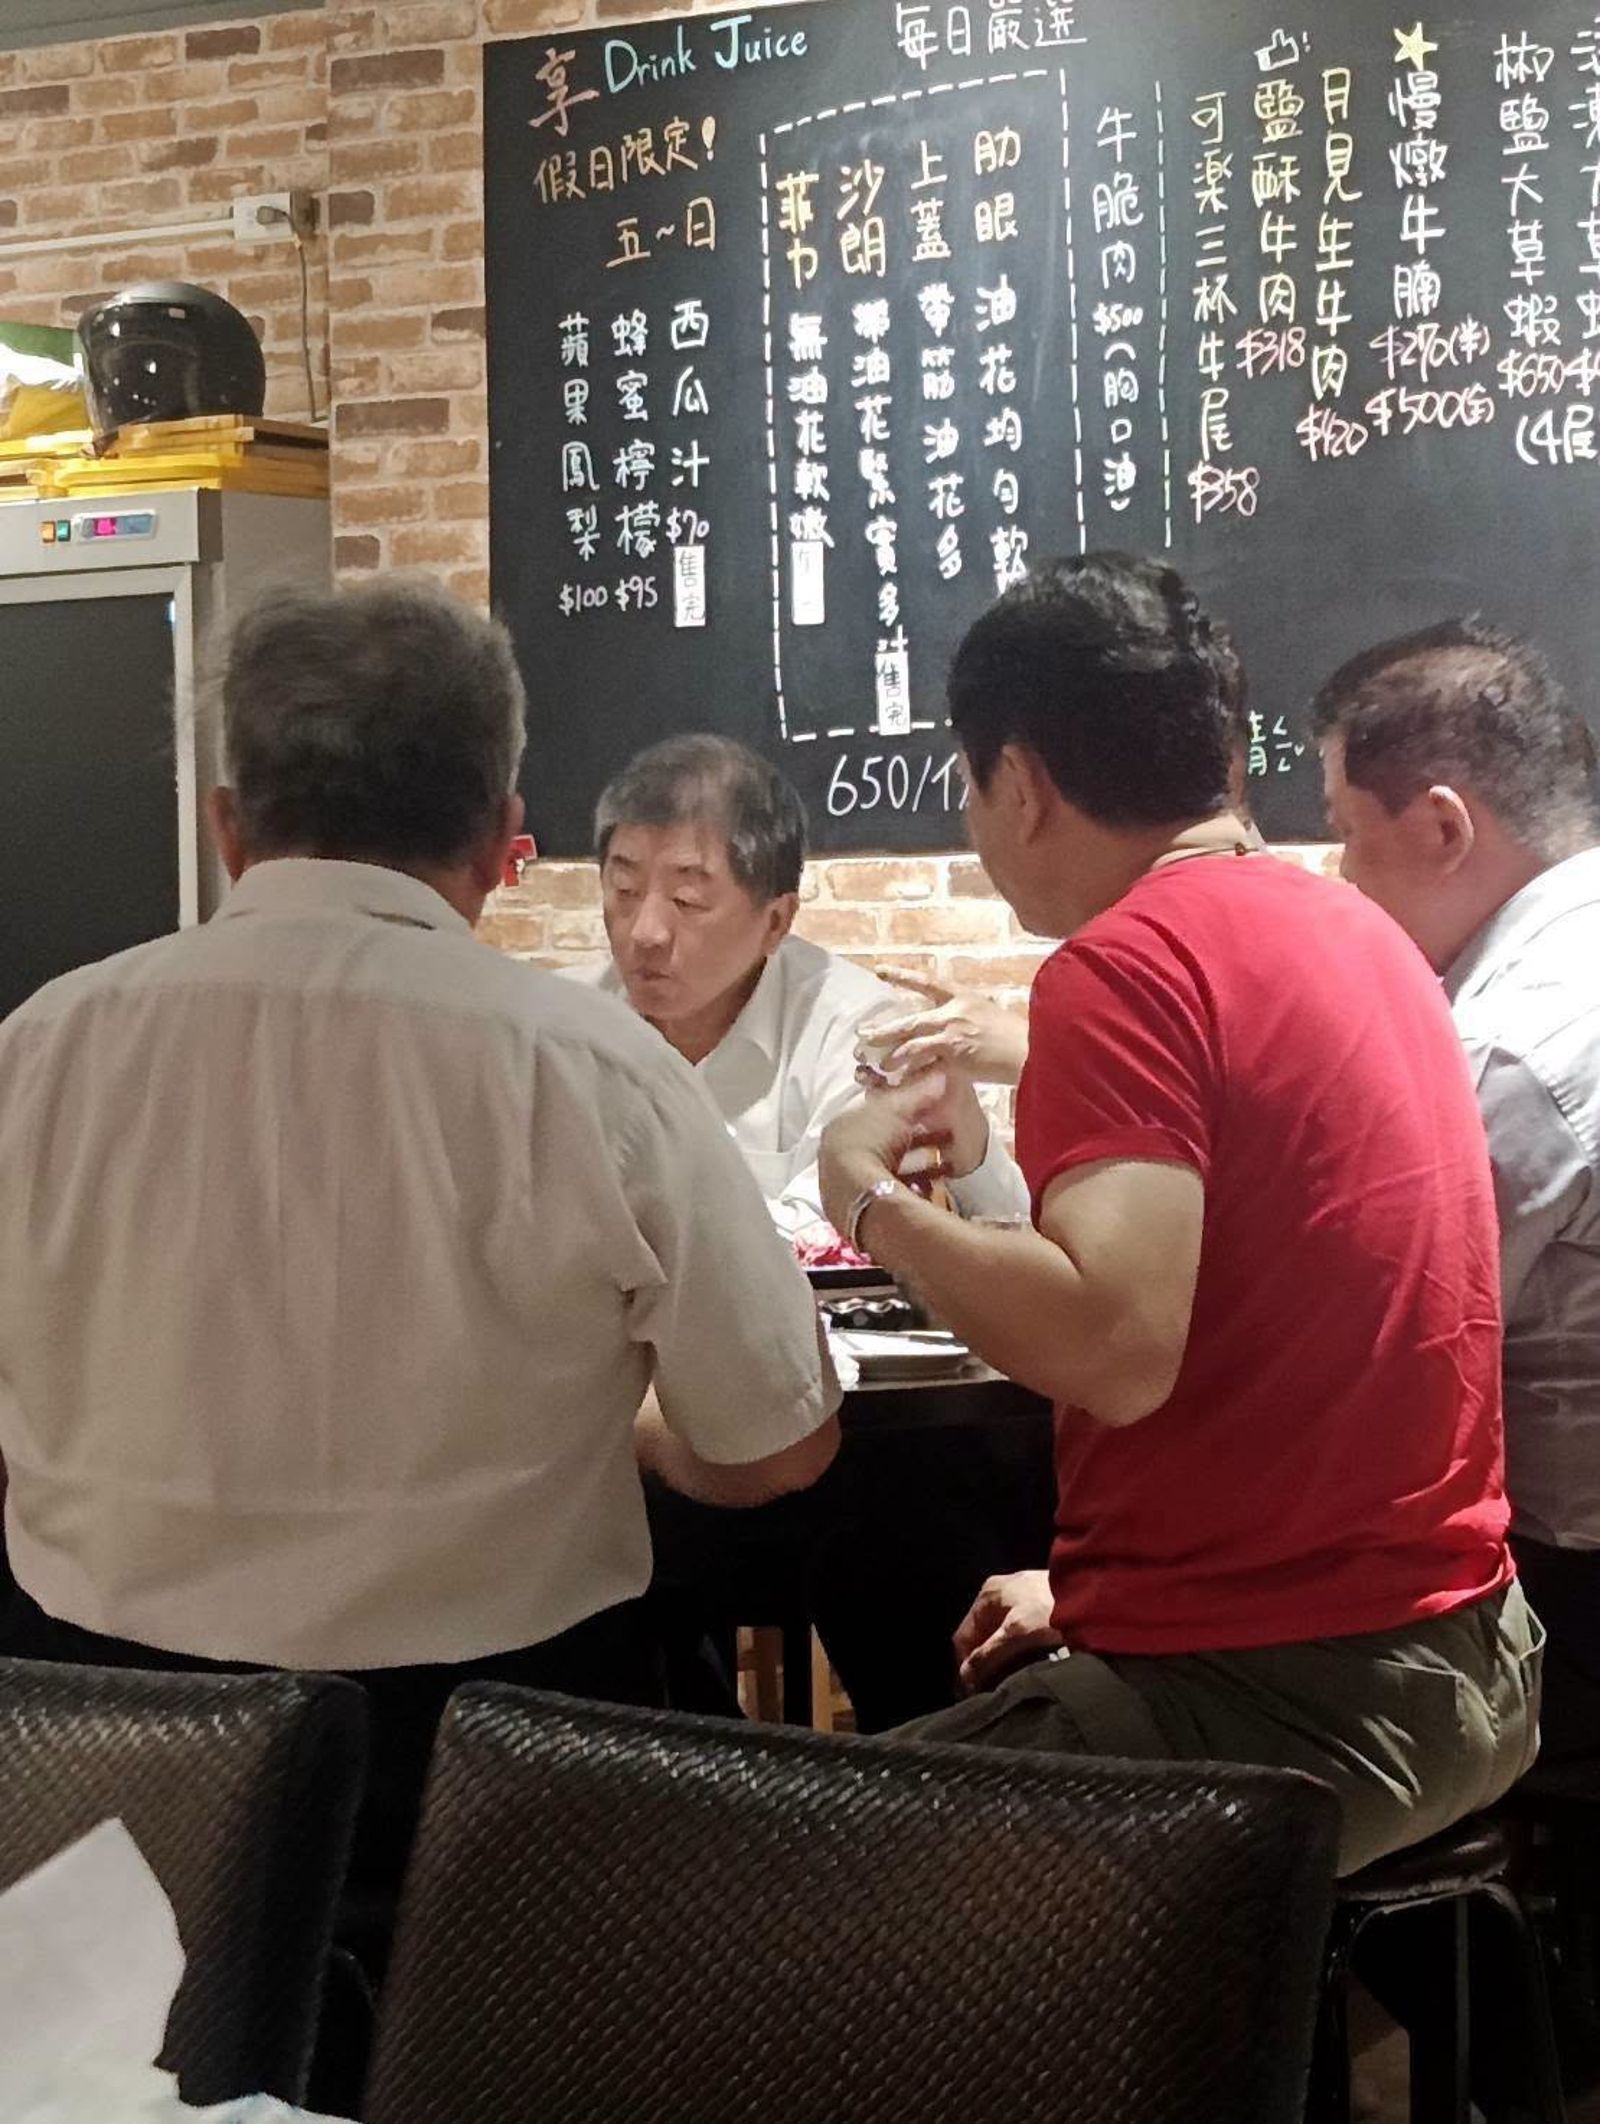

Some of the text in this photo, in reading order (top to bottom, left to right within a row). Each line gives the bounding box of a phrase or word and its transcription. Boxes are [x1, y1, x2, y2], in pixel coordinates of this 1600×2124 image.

[529, 47, 599, 136] 享
[605, 15, 807, 93] Drink Juice
[838, 159, 886, 277] 沙朗
[910, 140, 952, 261] 上蓋
[974, 126, 1021, 242] 肋眼
[1311, 67, 1362, 399] 月見生牛肉
[1093, 303, 1143, 336] $500
[1235, 326, 1306, 379] $318
[558, 312, 608, 616] 蘋果鳳梨 $100
[611, 309, 660, 611] 蜂蜜檸檬 $95
[665, 300, 709, 547] 西瓜汁 $70
[1187, 460, 1260, 524] $358
[827, 754, 969, 817] 650/1
